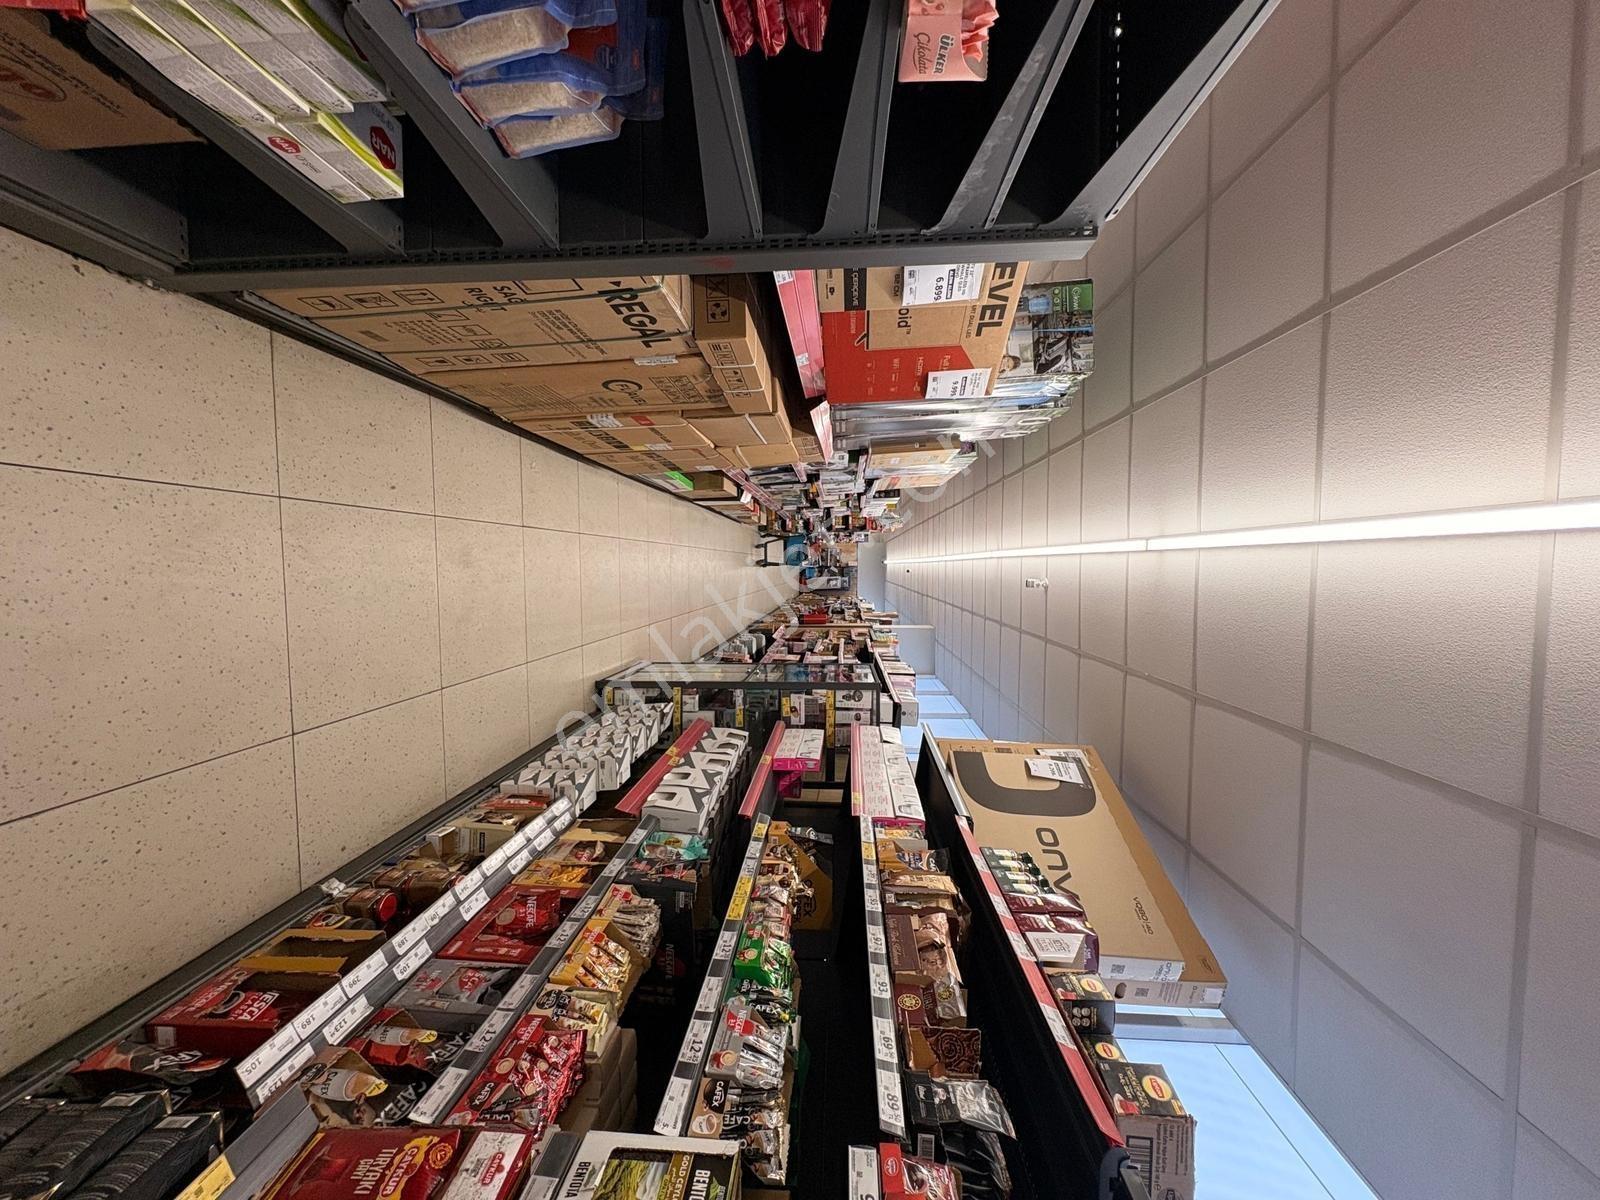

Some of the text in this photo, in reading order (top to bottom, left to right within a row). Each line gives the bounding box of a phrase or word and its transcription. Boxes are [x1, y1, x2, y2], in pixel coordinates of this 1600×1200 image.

[913, 32, 933, 75] Çikolata
[933, 34, 954, 74] ÜLKER
[271, 137, 298, 153] NAR
[371, 131, 397, 166] NAR
[464, 287, 508, 312] RIGT
[851, 272, 859, 306] ÇERÇEVE
[934, 276, 945, 301] 6.899
[598, 287, 671, 348] REGAL
[873, 937, 881, 946] 97
[399, 962, 411, 976] 105
[347, 974, 361, 988] 299
[878, 981, 888, 992] 93
[300, 1014, 316, 1030] 189
[690, 1040, 703, 1052] 12
[883, 1036, 894, 1049] 69
[243, 1059, 261, 1076] 105
[472, 1082, 495, 1105] CAFEX
[711, 1080, 724, 1107] CAFEX
[886, 1093, 900, 1110] 89
[679, 1154, 690, 1177] GOLD
[564, 1162, 591, 1198] BENTOTA
